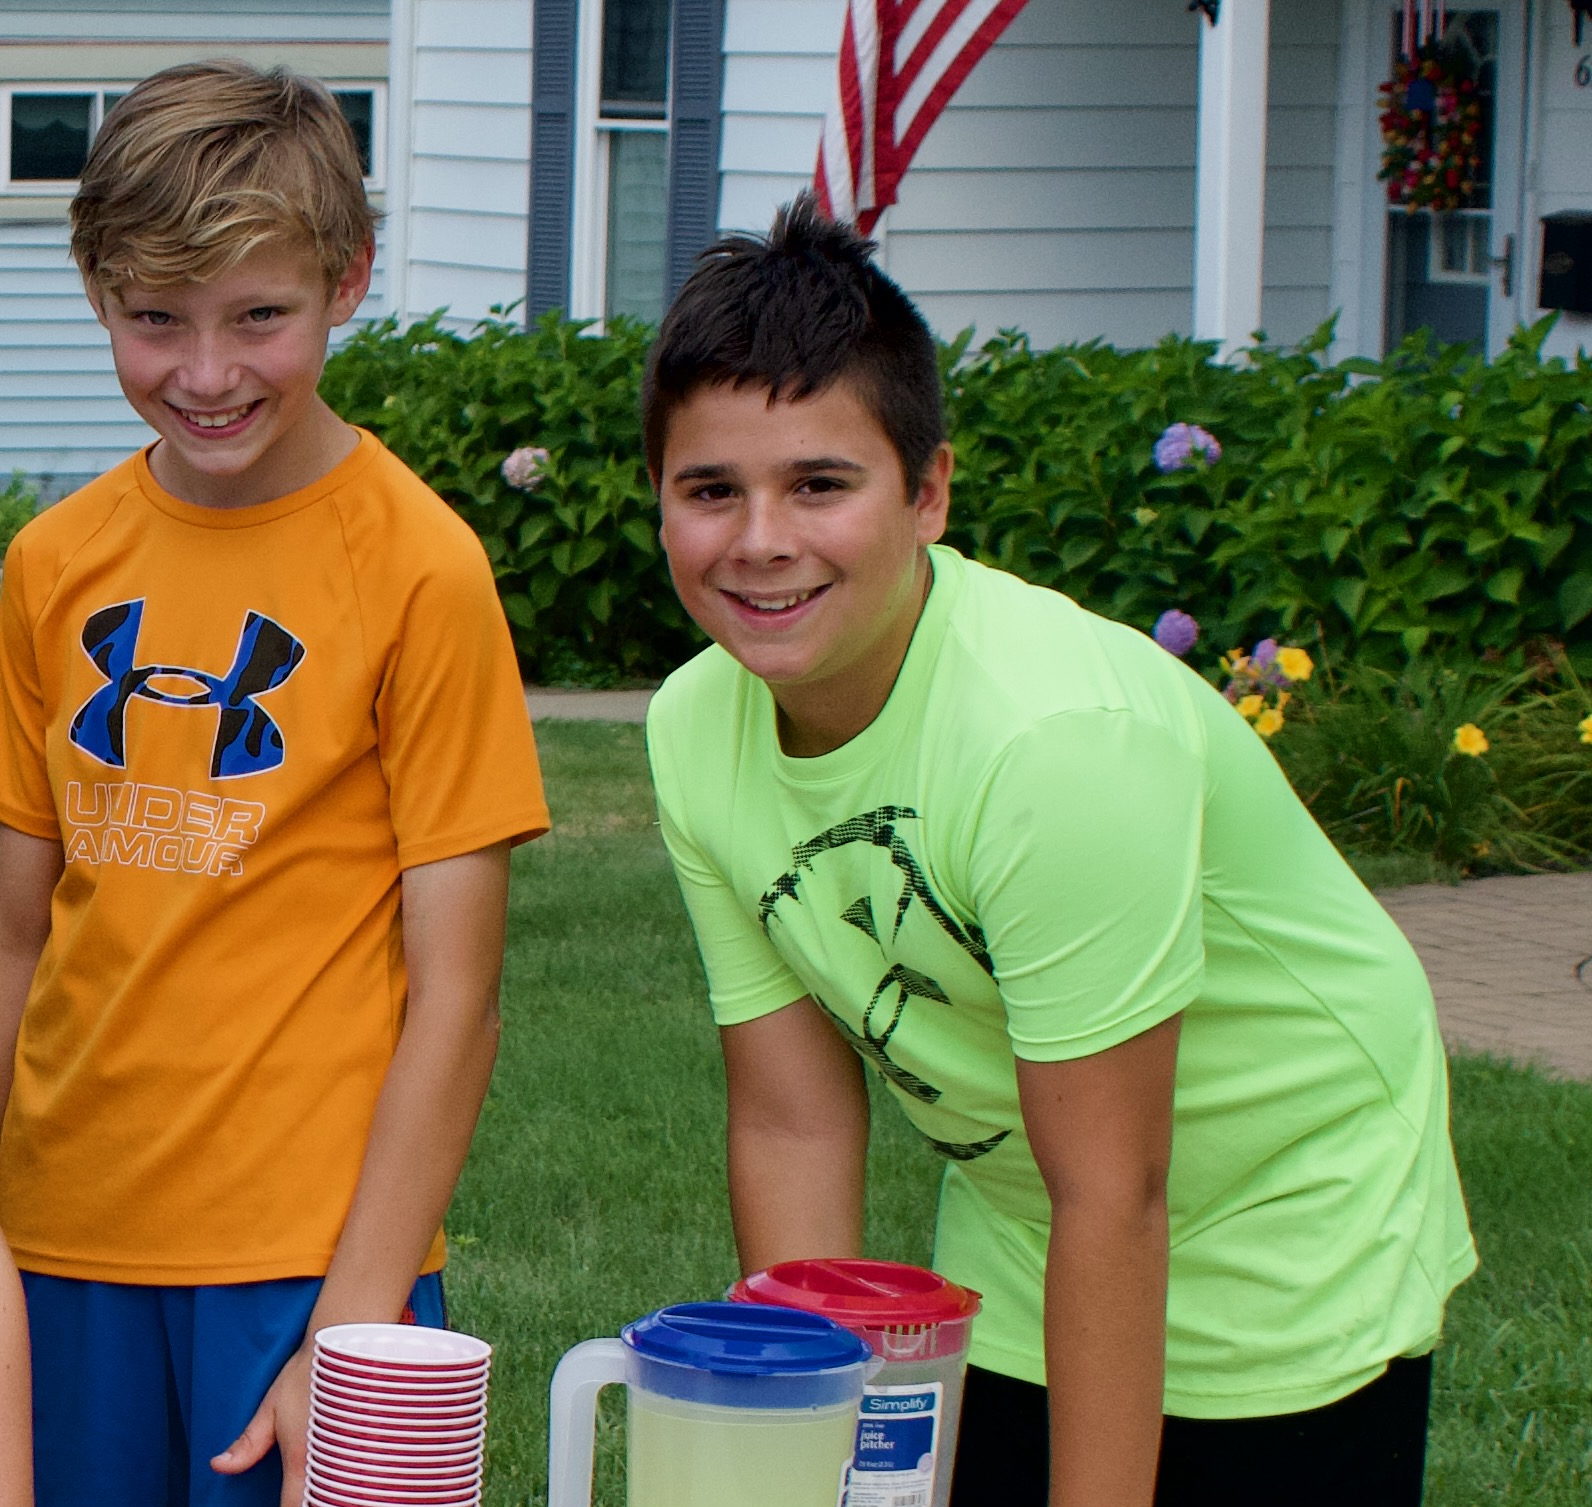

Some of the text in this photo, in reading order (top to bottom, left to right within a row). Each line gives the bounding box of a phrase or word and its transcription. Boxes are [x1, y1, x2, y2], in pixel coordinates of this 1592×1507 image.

[64, 827, 250, 877] AMOUR
[869, 1397, 928, 1412] Simplify
[860, 1429, 886, 1441] juice
[859, 1439, 896, 1450] pitcher
